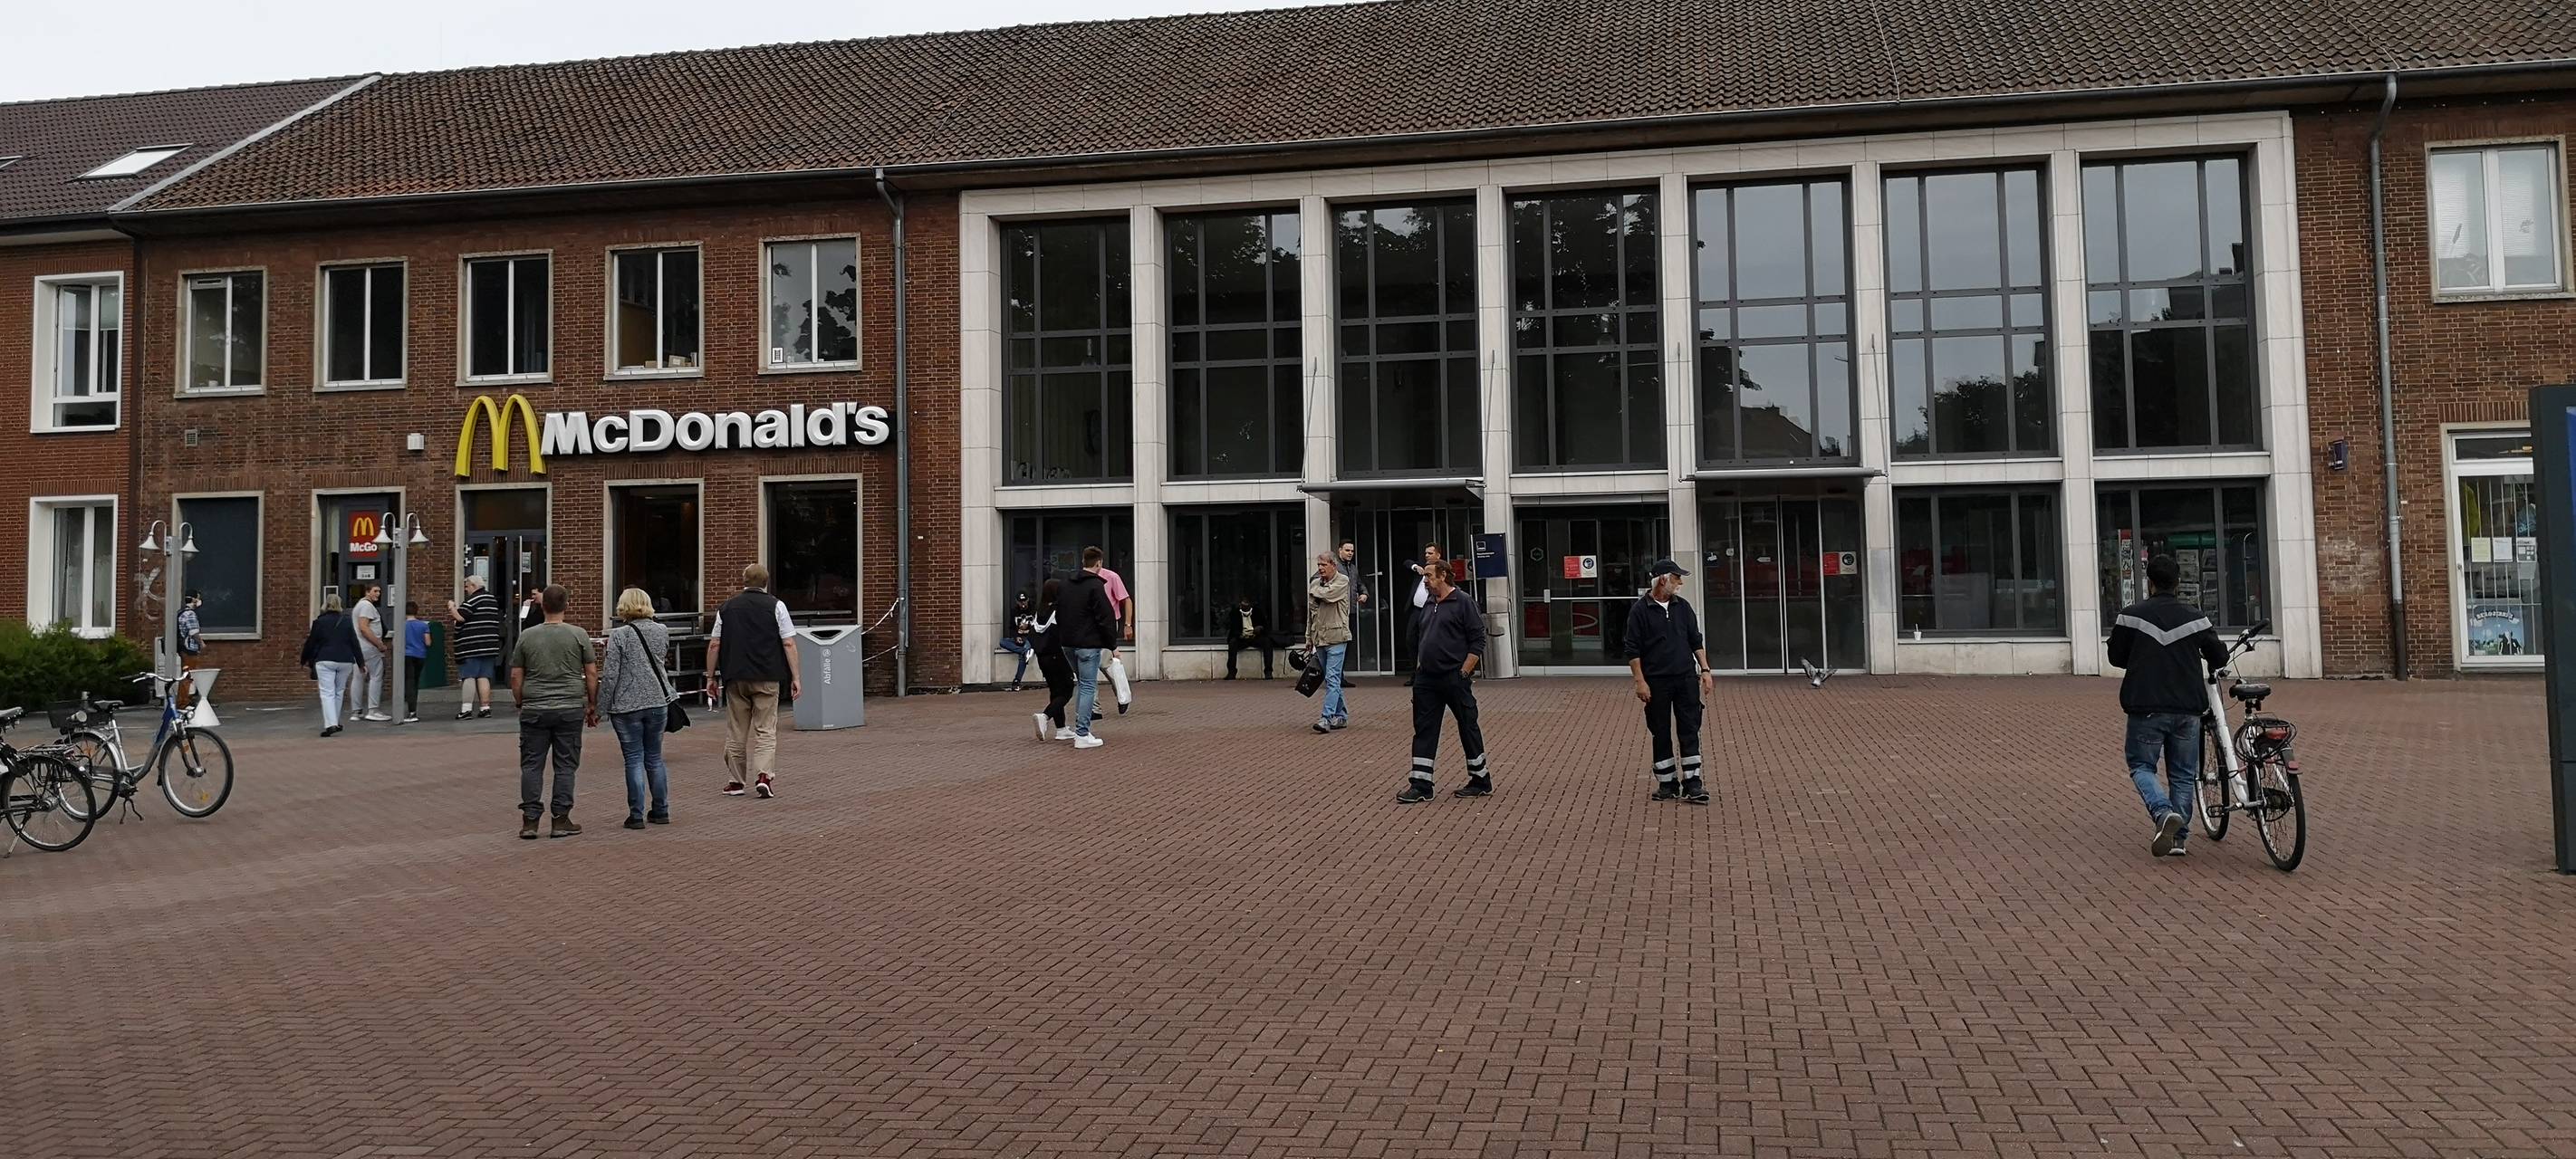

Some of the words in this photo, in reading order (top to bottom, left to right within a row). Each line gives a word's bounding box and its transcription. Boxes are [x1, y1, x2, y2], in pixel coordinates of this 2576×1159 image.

[541, 401, 890, 455] McDonald's
[350, 542, 378, 552] McGo
[822, 658, 831, 685] Abfälle
